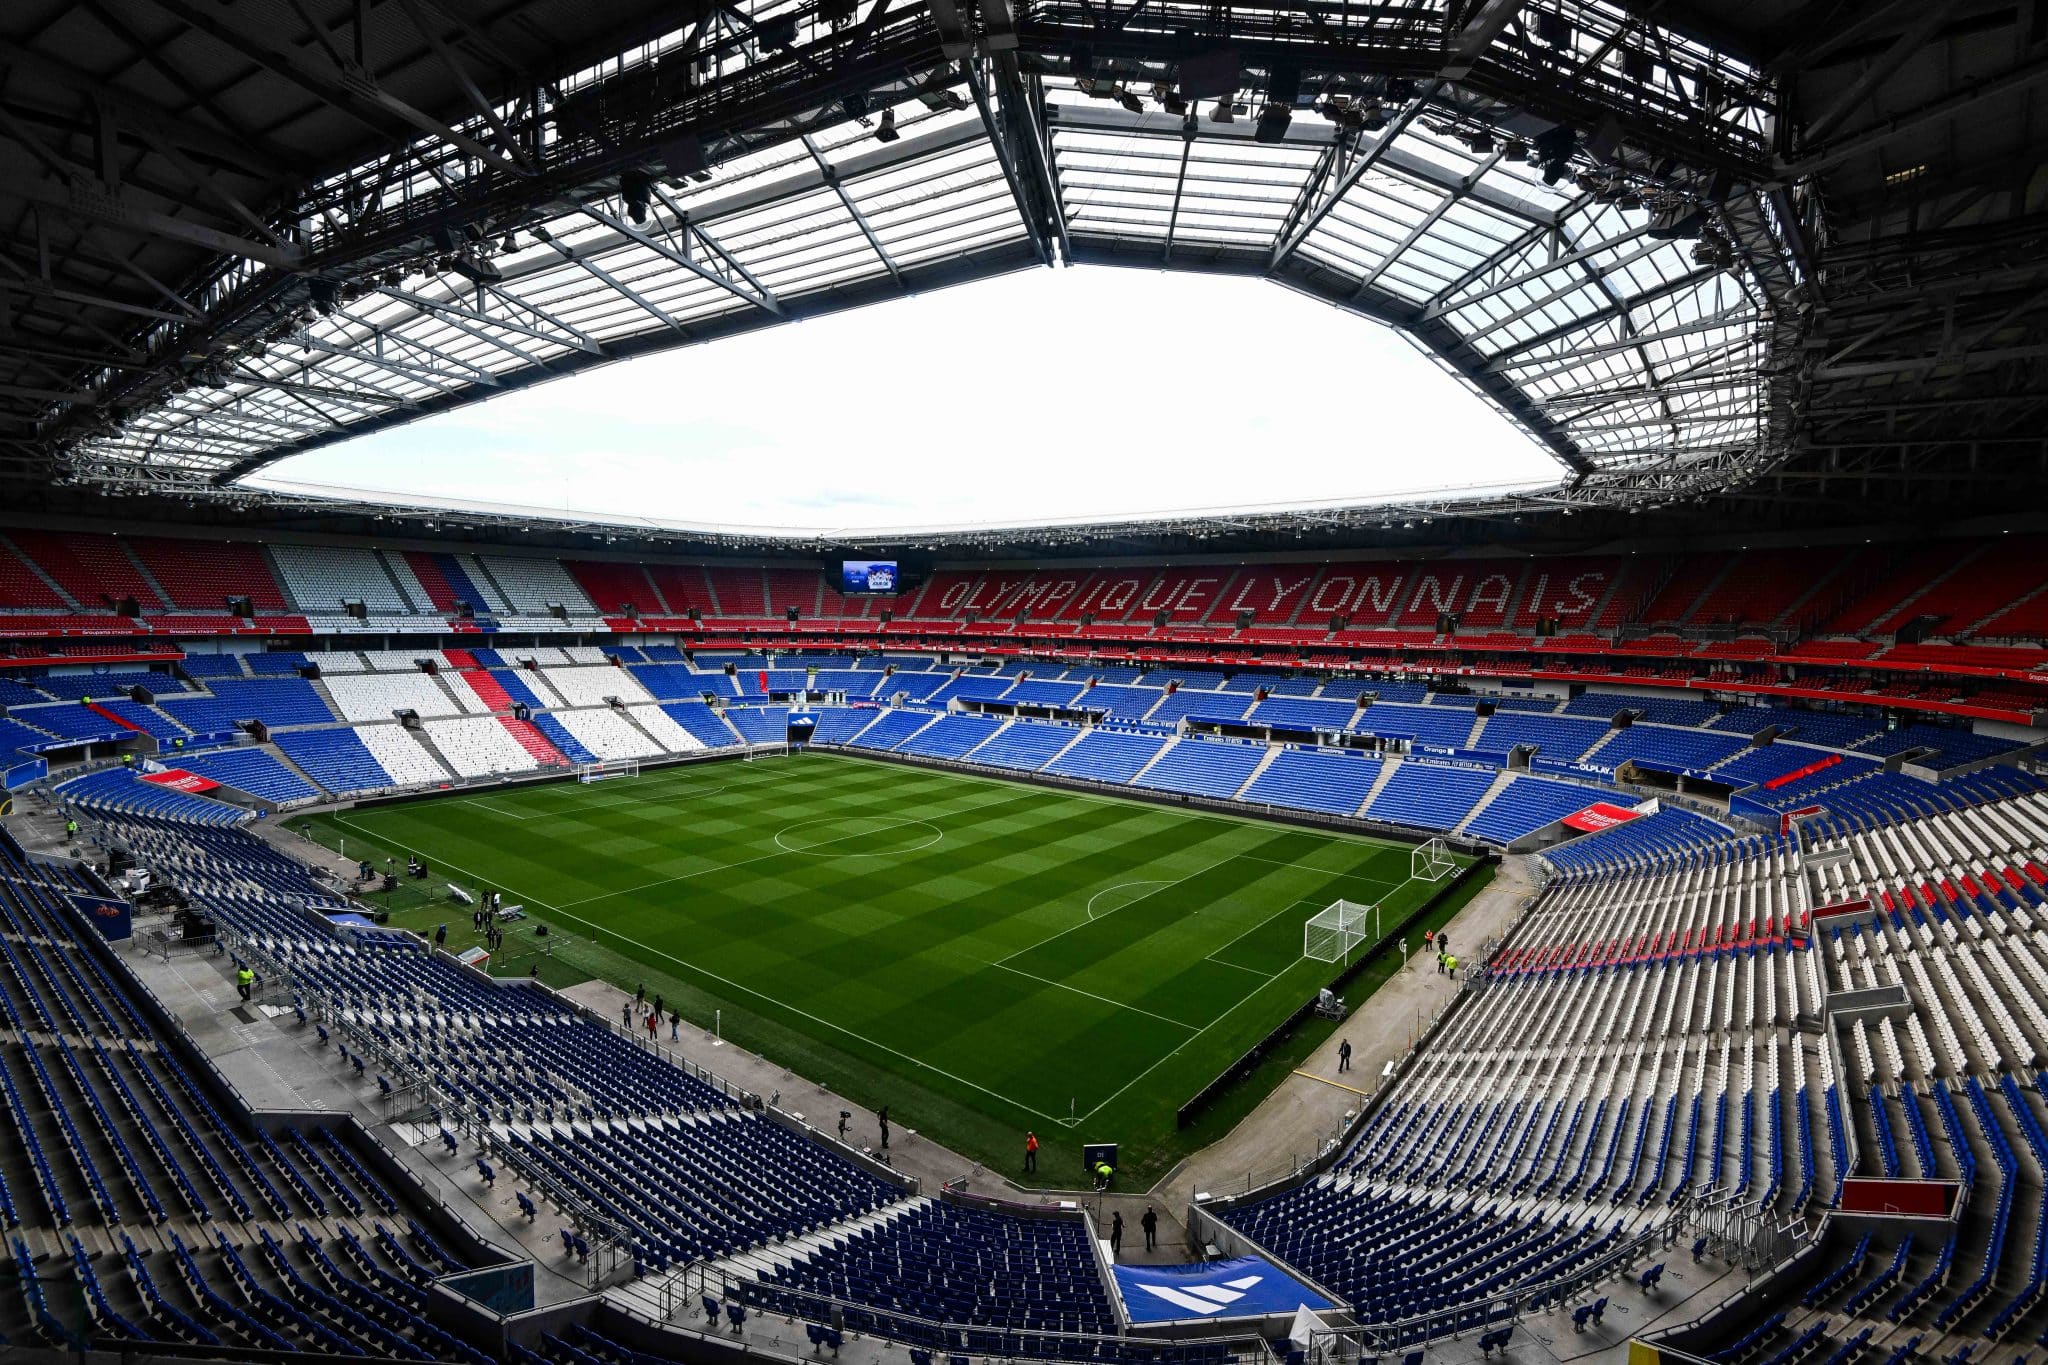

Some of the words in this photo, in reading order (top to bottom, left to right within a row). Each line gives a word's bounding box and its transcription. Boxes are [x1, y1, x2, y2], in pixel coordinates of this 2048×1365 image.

[940, 578, 1218, 612] OLYMPIQUE
[1234, 572, 1605, 614] LYONNAIS
[1424, 746, 1447, 755] Orange
[1426, 758, 1451, 766] Emirates
[1579, 763, 1610, 775] OLPLAY
